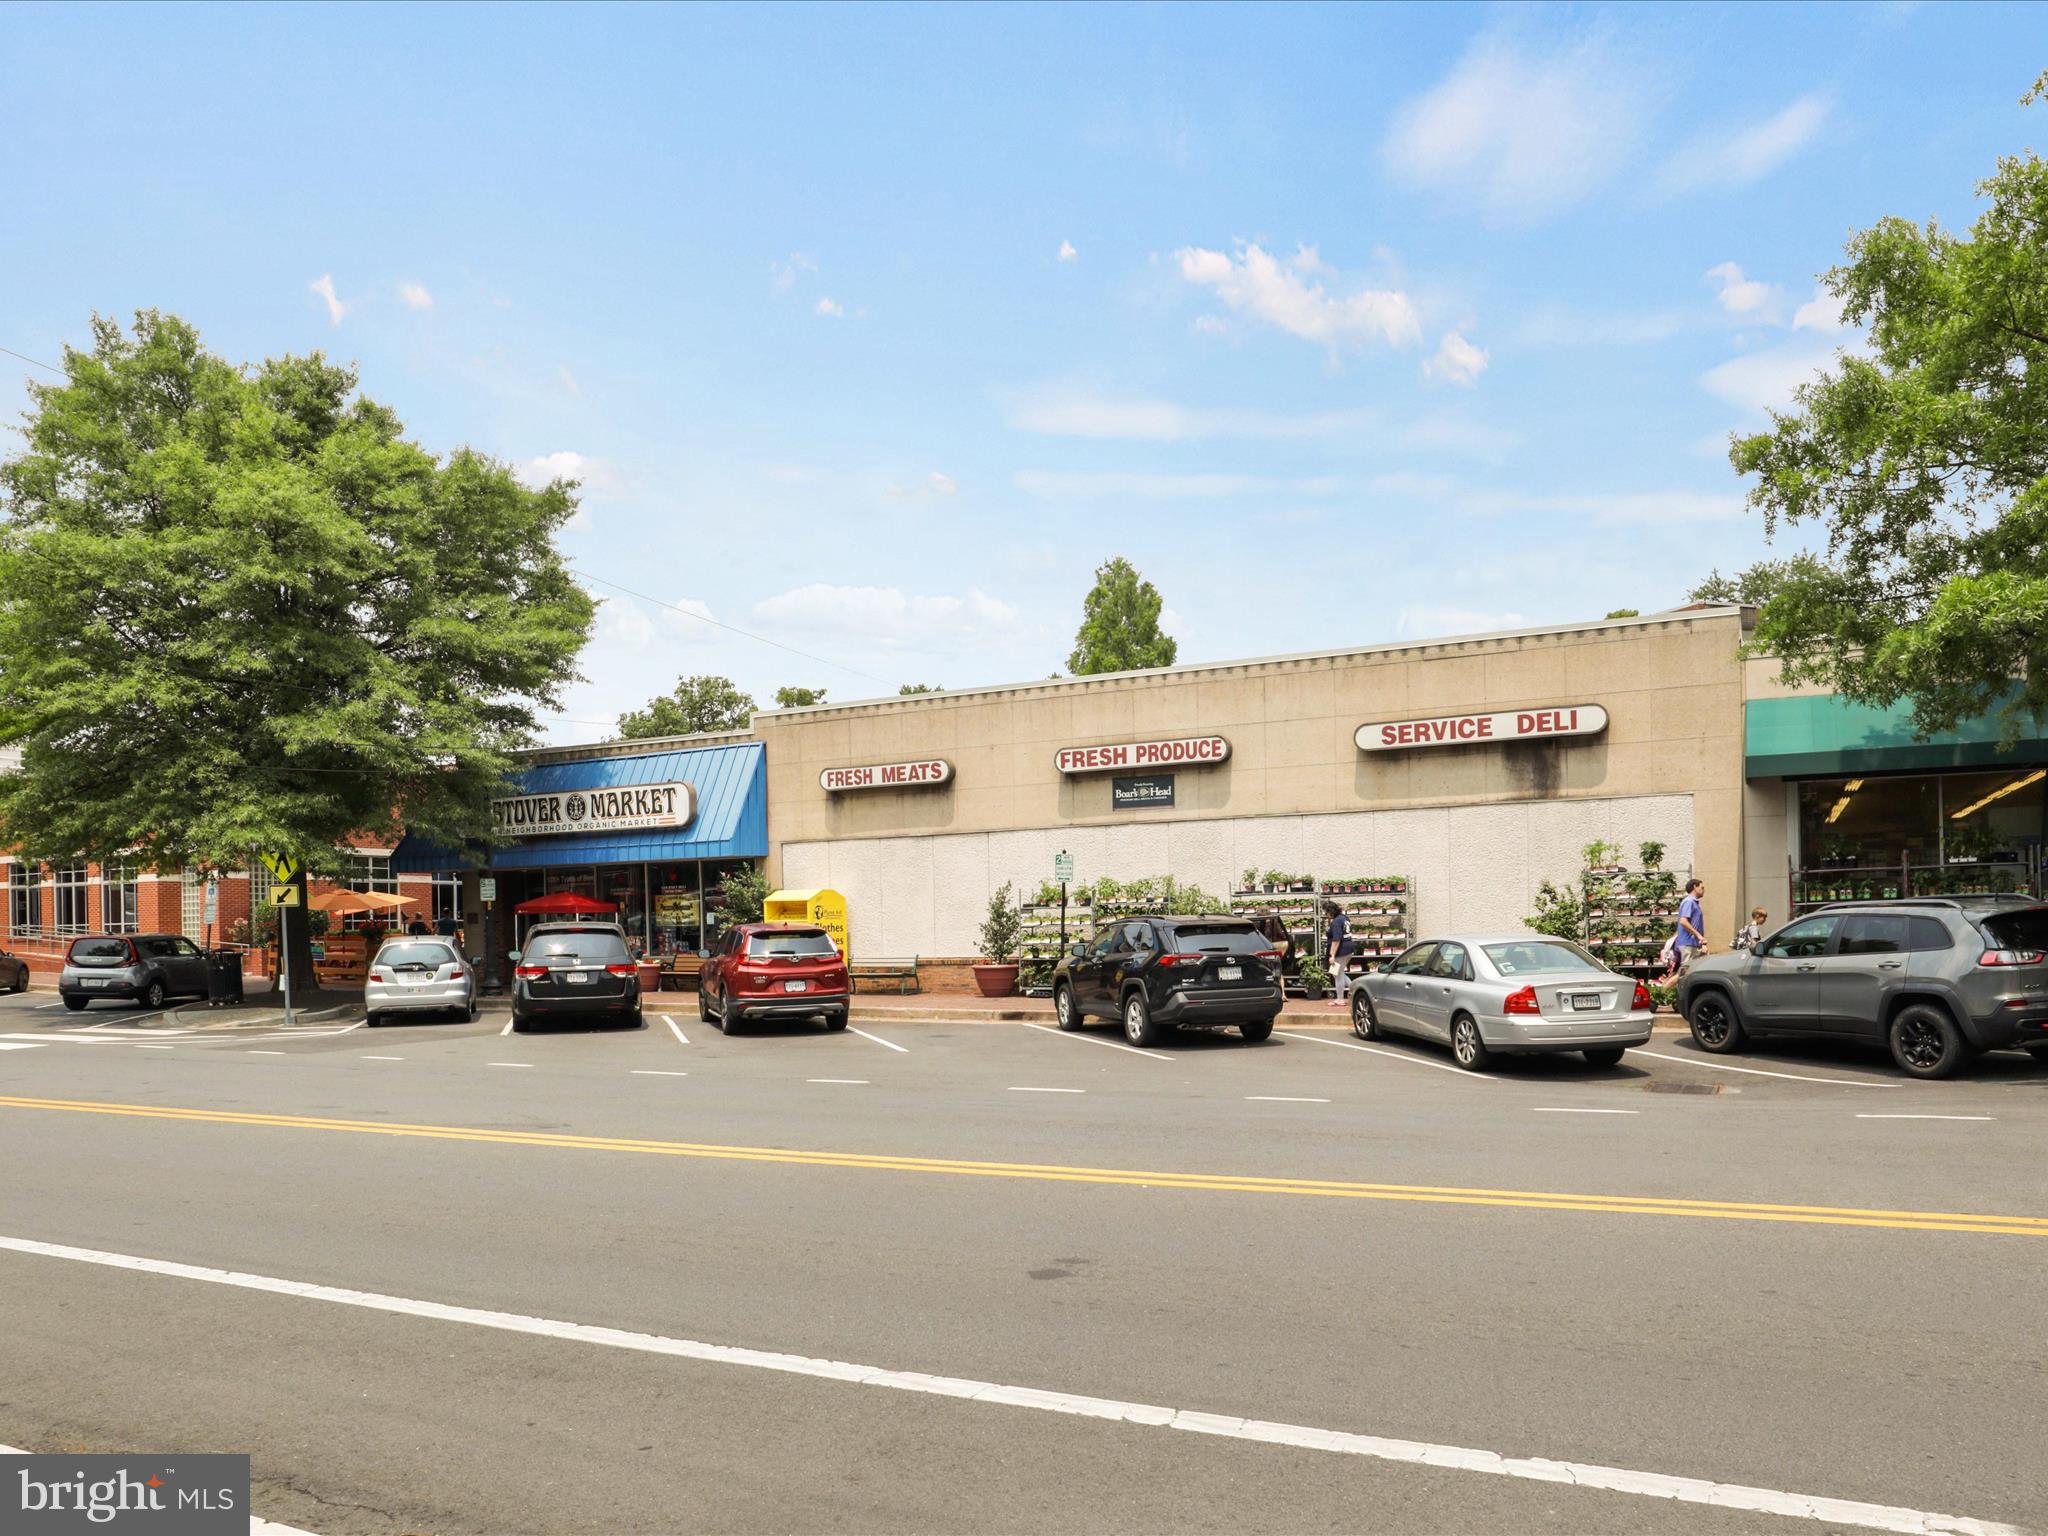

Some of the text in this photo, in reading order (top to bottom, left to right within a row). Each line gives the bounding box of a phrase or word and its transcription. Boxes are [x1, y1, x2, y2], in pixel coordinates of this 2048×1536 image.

[1381, 710, 1577, 745] SERVICE DELI
[1060, 739, 1222, 769] FRESH PRODUCE
[827, 762, 942, 787] FRESH MEATS
[590, 787, 676, 819] MARKET
[1115, 785, 1171, 798] Boar's Head
[506, 824, 573, 835] NEIGHBORHOOD
[577, 820, 616, 830] ORGANIC
[620, 818, 657, 826] MARKET
